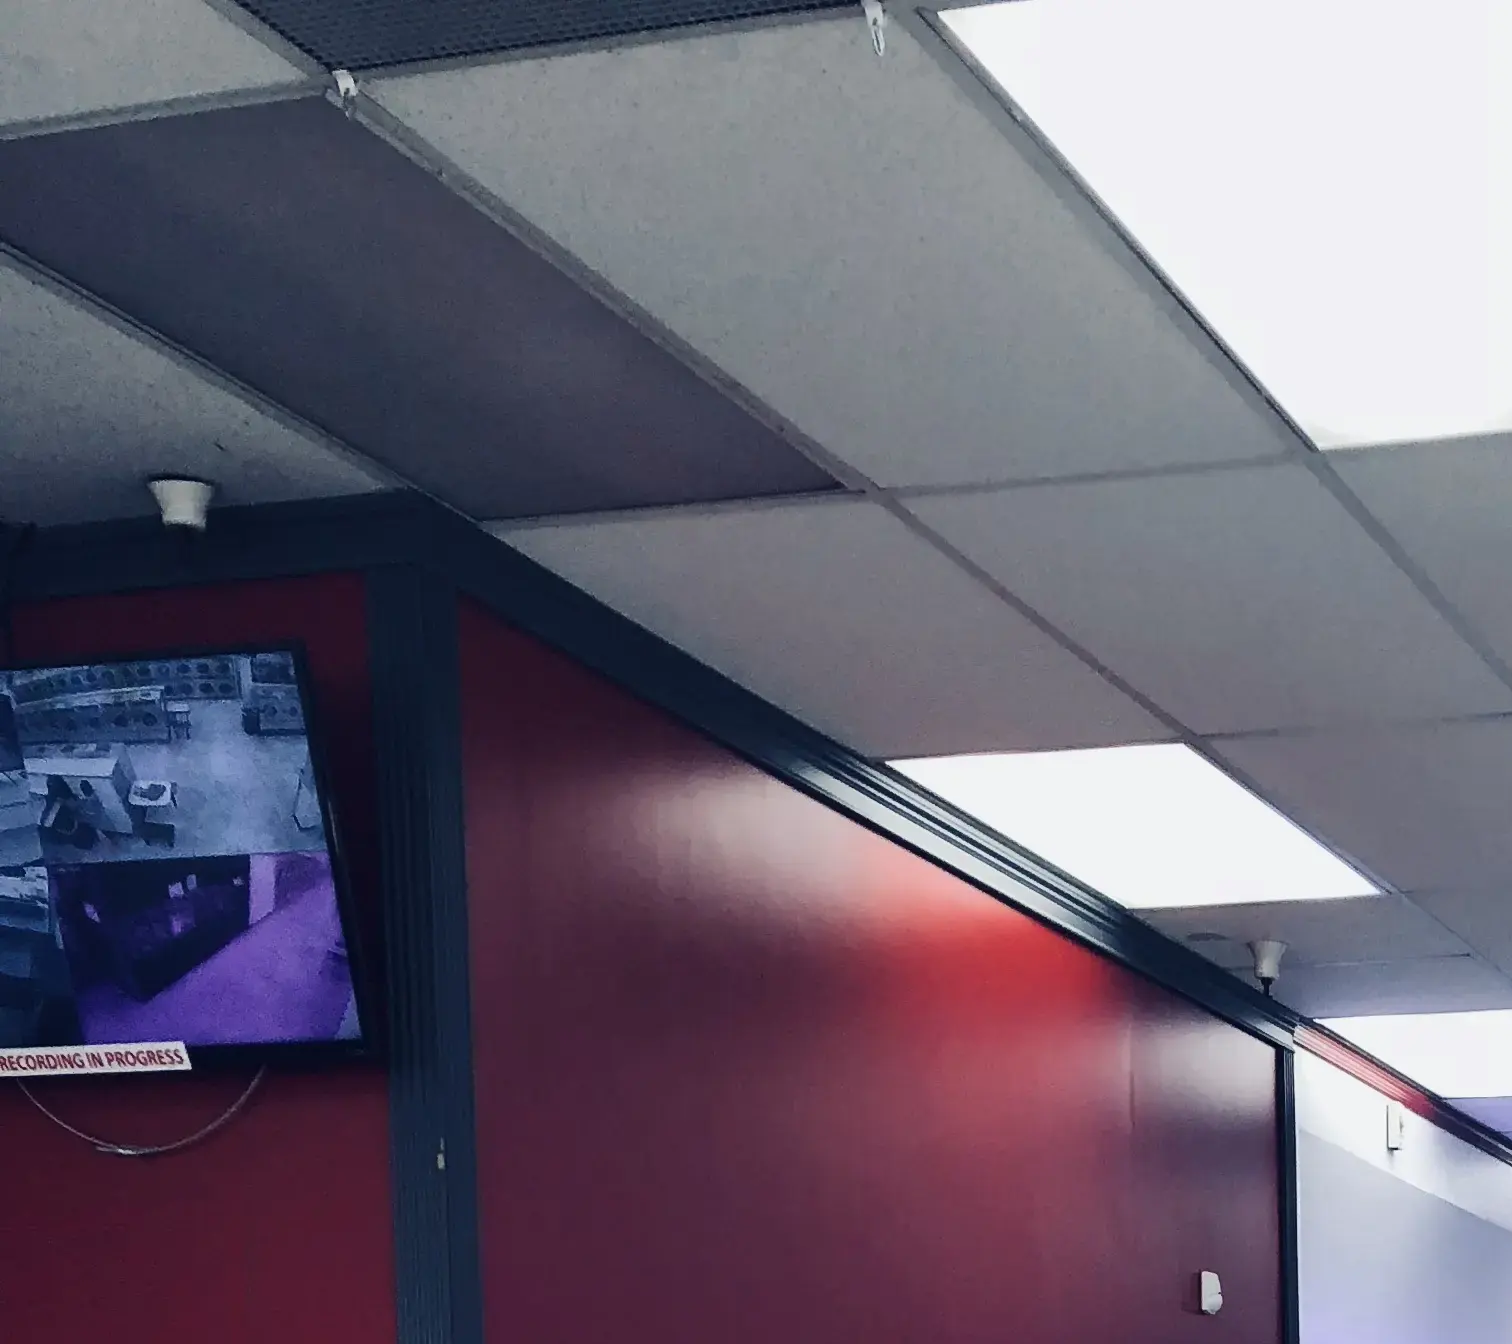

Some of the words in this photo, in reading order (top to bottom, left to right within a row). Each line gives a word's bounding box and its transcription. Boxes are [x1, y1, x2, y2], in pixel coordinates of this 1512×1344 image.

[0, 1052, 85, 1071] RECORDING
[87, 1052, 104, 1069] IN
[104, 1049, 184, 1068] PROGRESS
